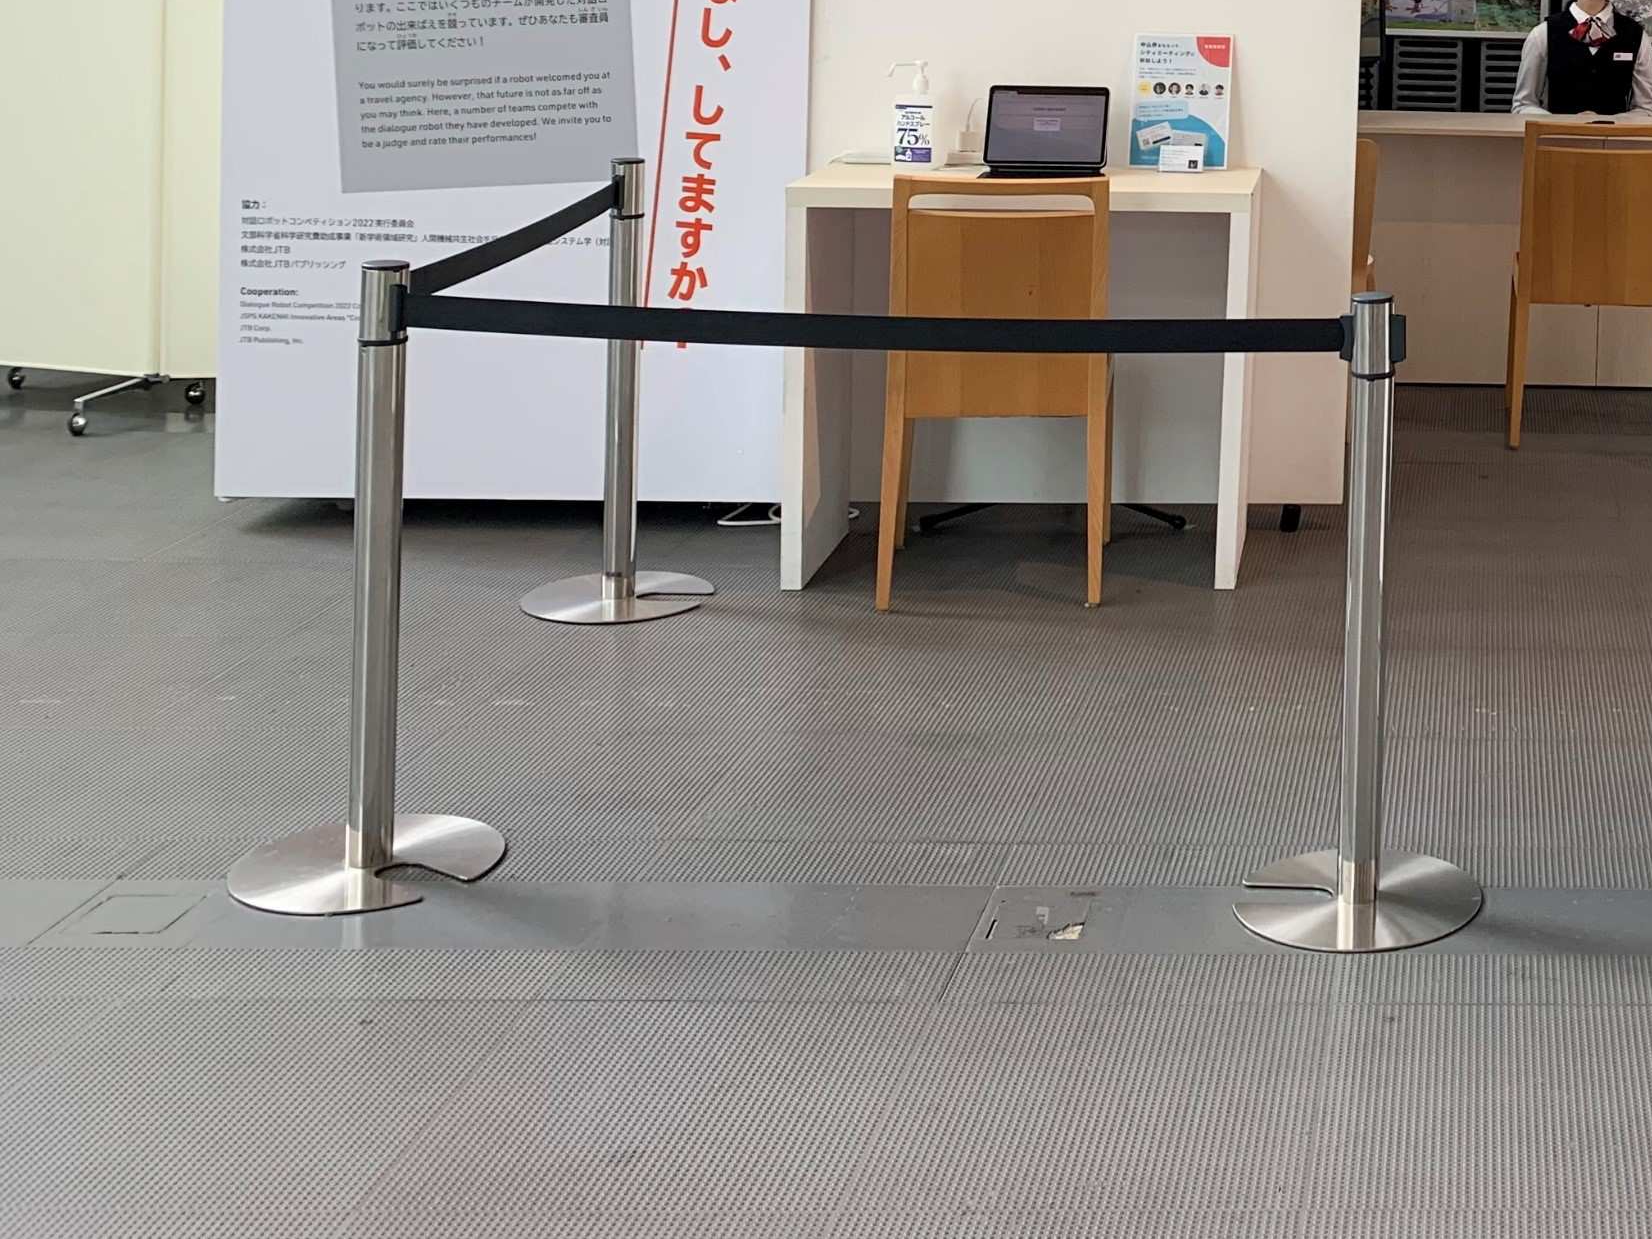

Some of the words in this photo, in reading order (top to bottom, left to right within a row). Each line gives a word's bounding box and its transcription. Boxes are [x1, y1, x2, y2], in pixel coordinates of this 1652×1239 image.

[358, 81, 375, 90] You
[377, 80, 405, 89] would
[407, 79, 435, 89] surely
[437, 78, 448, 87] be
[450, 77, 492, 87] surprised
[509, 74, 534, 83] robot
[536, 72, 581, 82] welcomed
[583, 73, 600, 82] you
[601, 72, 611, 80] at
[367, 95, 393, 104] travel
[432, 93, 474, 102] However,
[476, 91, 494, 100] that
[496, 90, 523, 99] future
[525, 89, 533, 97] is
[535, 89, 549, 97] not
[563, 87, 576, 96] far
[577, 87, 590, 95] off
[360, 112, 377, 120] you
[378, 111, 398, 120] may
[426, 107, 452, 117] Here,
[461, 105, 495, 115] number
[497, 104, 507, 113] of
[508, 104, 536, 113] teams
[538, 103, 577, 113] compete
[578, 100, 598, 109] with
[361, 125, 376, 134] the
[377, 123, 417, 134] dialogue
[419, 122, 443, 131] robot
[445, 121, 465, 131] they
[466, 121, 488, 130] have
[541, 116, 557, 126] We
[558, 115, 583, 124] invite
[584, 116, 601, 126] you
[602, 115, 612, 123] to
[362, 140, 373, 149] be
[382, 138, 409, 149] judge
[410, 137, 427, 147] and
[428, 137, 447, 145] rate
[448, 135, 469, 145] their
[471, 132, 537, 146] performances!
[896, 128, 930, 146] 75%
[240, 287, 299, 297] Cooperation:
